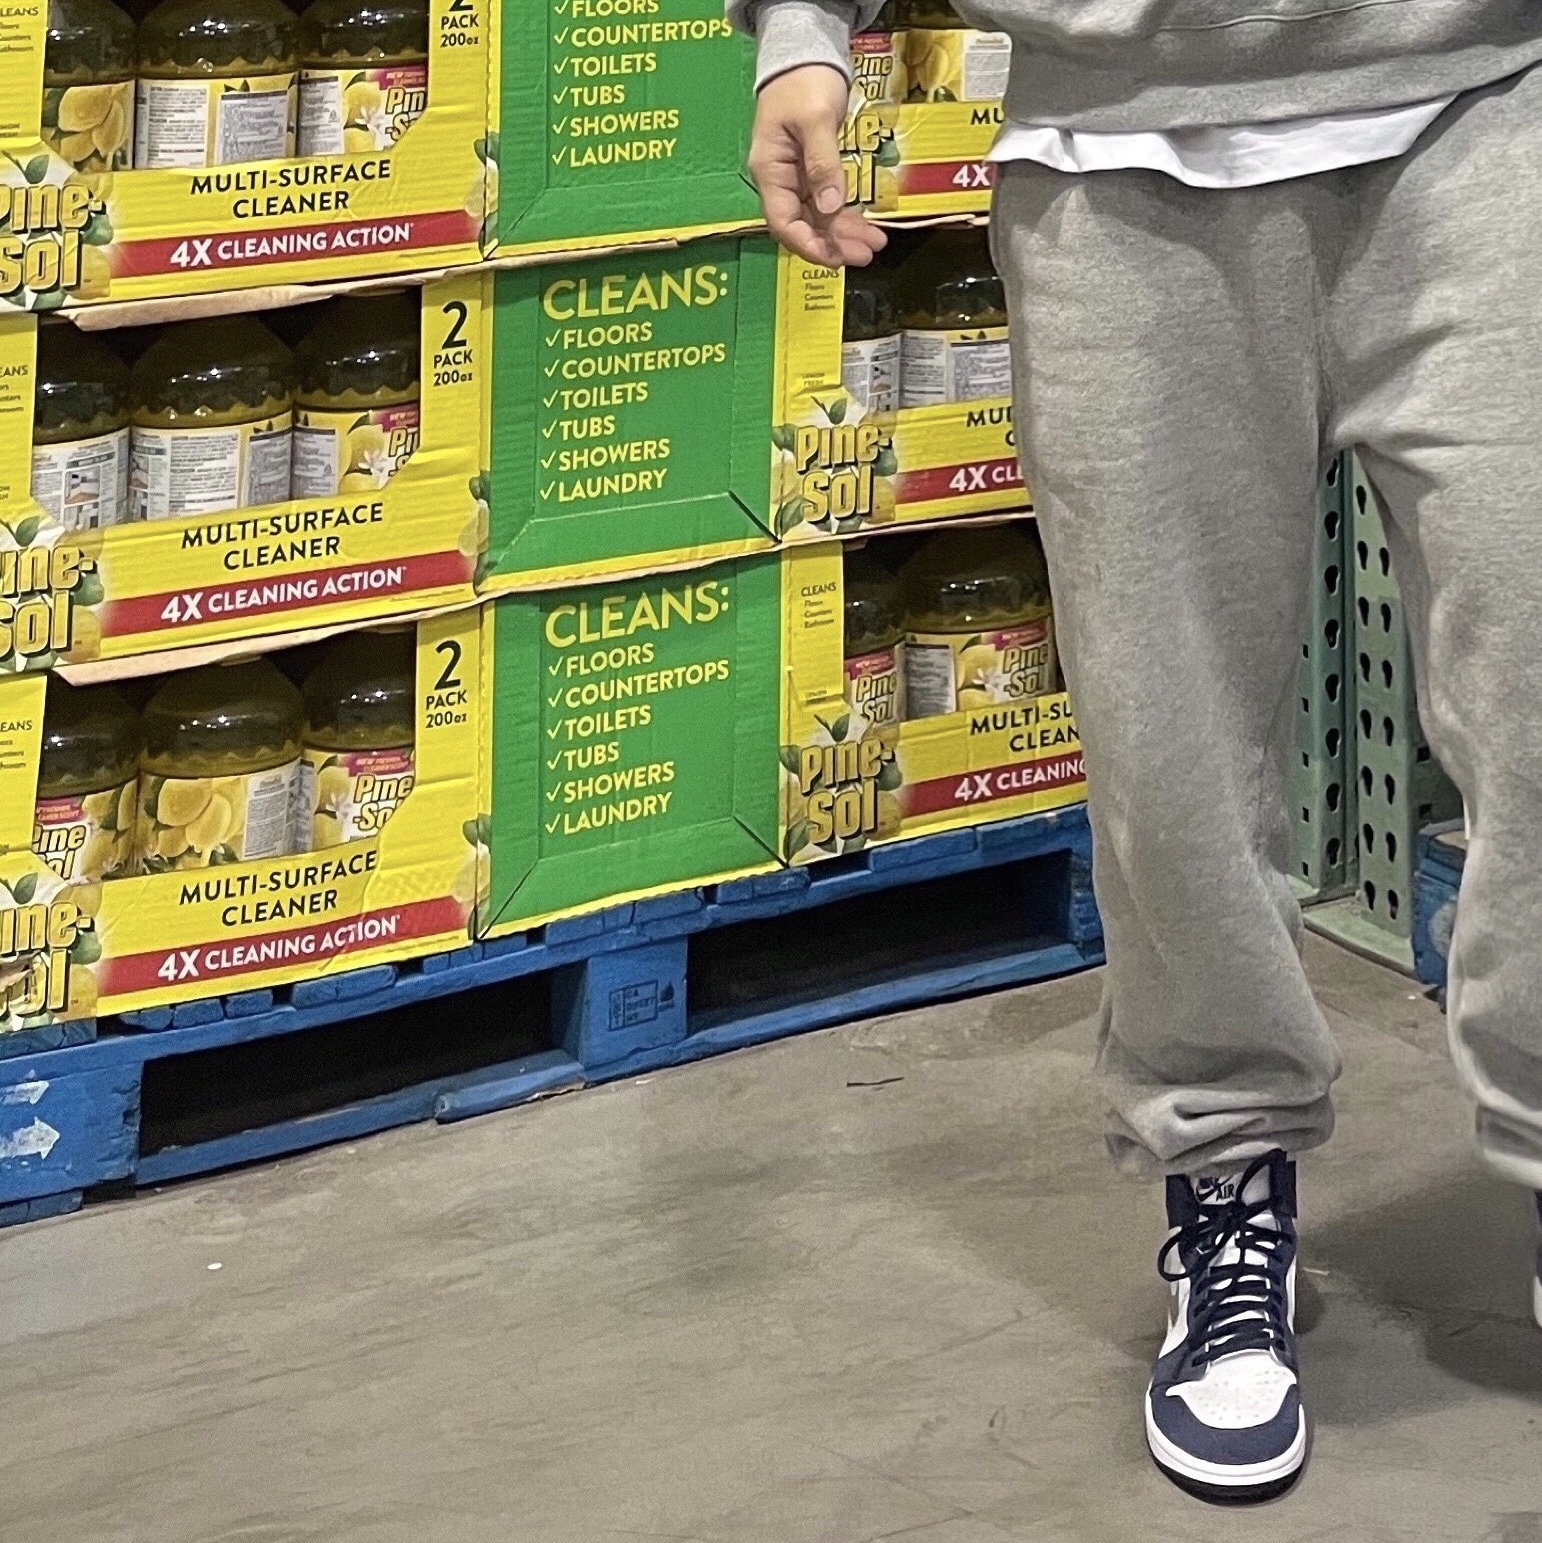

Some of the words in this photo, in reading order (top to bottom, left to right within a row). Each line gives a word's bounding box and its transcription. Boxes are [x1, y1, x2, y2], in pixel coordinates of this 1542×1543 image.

[440, 14, 479, 30] PACK
[571, 20, 733, 47] COUNTERTOPS
[571, 53, 657, 76] TOILETS
[570, 85, 626, 105] TUBS
[570, 110, 679, 136] SHOWERS
[569, 139, 677, 168] LAUNDRY
[190, 160, 391, 195] MULTI-SURFACE
[232, 191, 349, 218] CLEANER
[170, 238, 213, 268] 4X
[217, 232, 327, 261] CLEANING
[330, 224, 410, 251] ACTION
[802, 268, 840, 280] CLEANS
[543, 265, 729, 321] CLEANS:
[442, 300, 468, 349] 2
[563, 322, 652, 348] FLOORS
[433, 349, 473, 368] PACK
[562, 343, 726, 379] COUNTERTOPS
[561, 382, 649, 408] TOILETS
[560, 416, 616, 439] TUBS
[559, 439, 670, 472] SHOWERS
[796, 424, 892, 474] Pine-
[558, 469, 668, 502] LAUNDRY
[801, 464, 873, 525] Sol
[949, 464, 988, 493] 4X
[181, 502, 384, 549] MULTI-SURFACE
[223, 536, 341, 571] CLEANER
[161, 591, 204, 623] 4X
[208, 580, 318, 614] CLEANING
[321, 568, 402, 597] ACTION
[801, 583, 837, 598] CLEANS
[545, 582, 729, 650] CLEANS:
[434, 639, 463, 688] 2
[566, 643, 655, 678] FLOORS
[426, 689, 468, 712] PACK
[565, 659, 730, 709] COUNTERTOPS
[565, 706, 651, 741] TOILETS
[563, 741, 620, 772] TUBS
[801, 737, 896, 795] Pine-
[563, 761, 675, 804] SHOWERS
[954, 773, 991, 802] 4X
[562, 792, 673, 836] LAUNDRY
[805, 777, 878, 843] Sol
[179, 850, 378, 907] MULTI-SURFACE
[221, 889, 338, 928] CLEANER
[157, 949, 200, 982] 4X
[204, 929, 315, 971] CLEANING
[319, 916, 397, 952] ACTION
